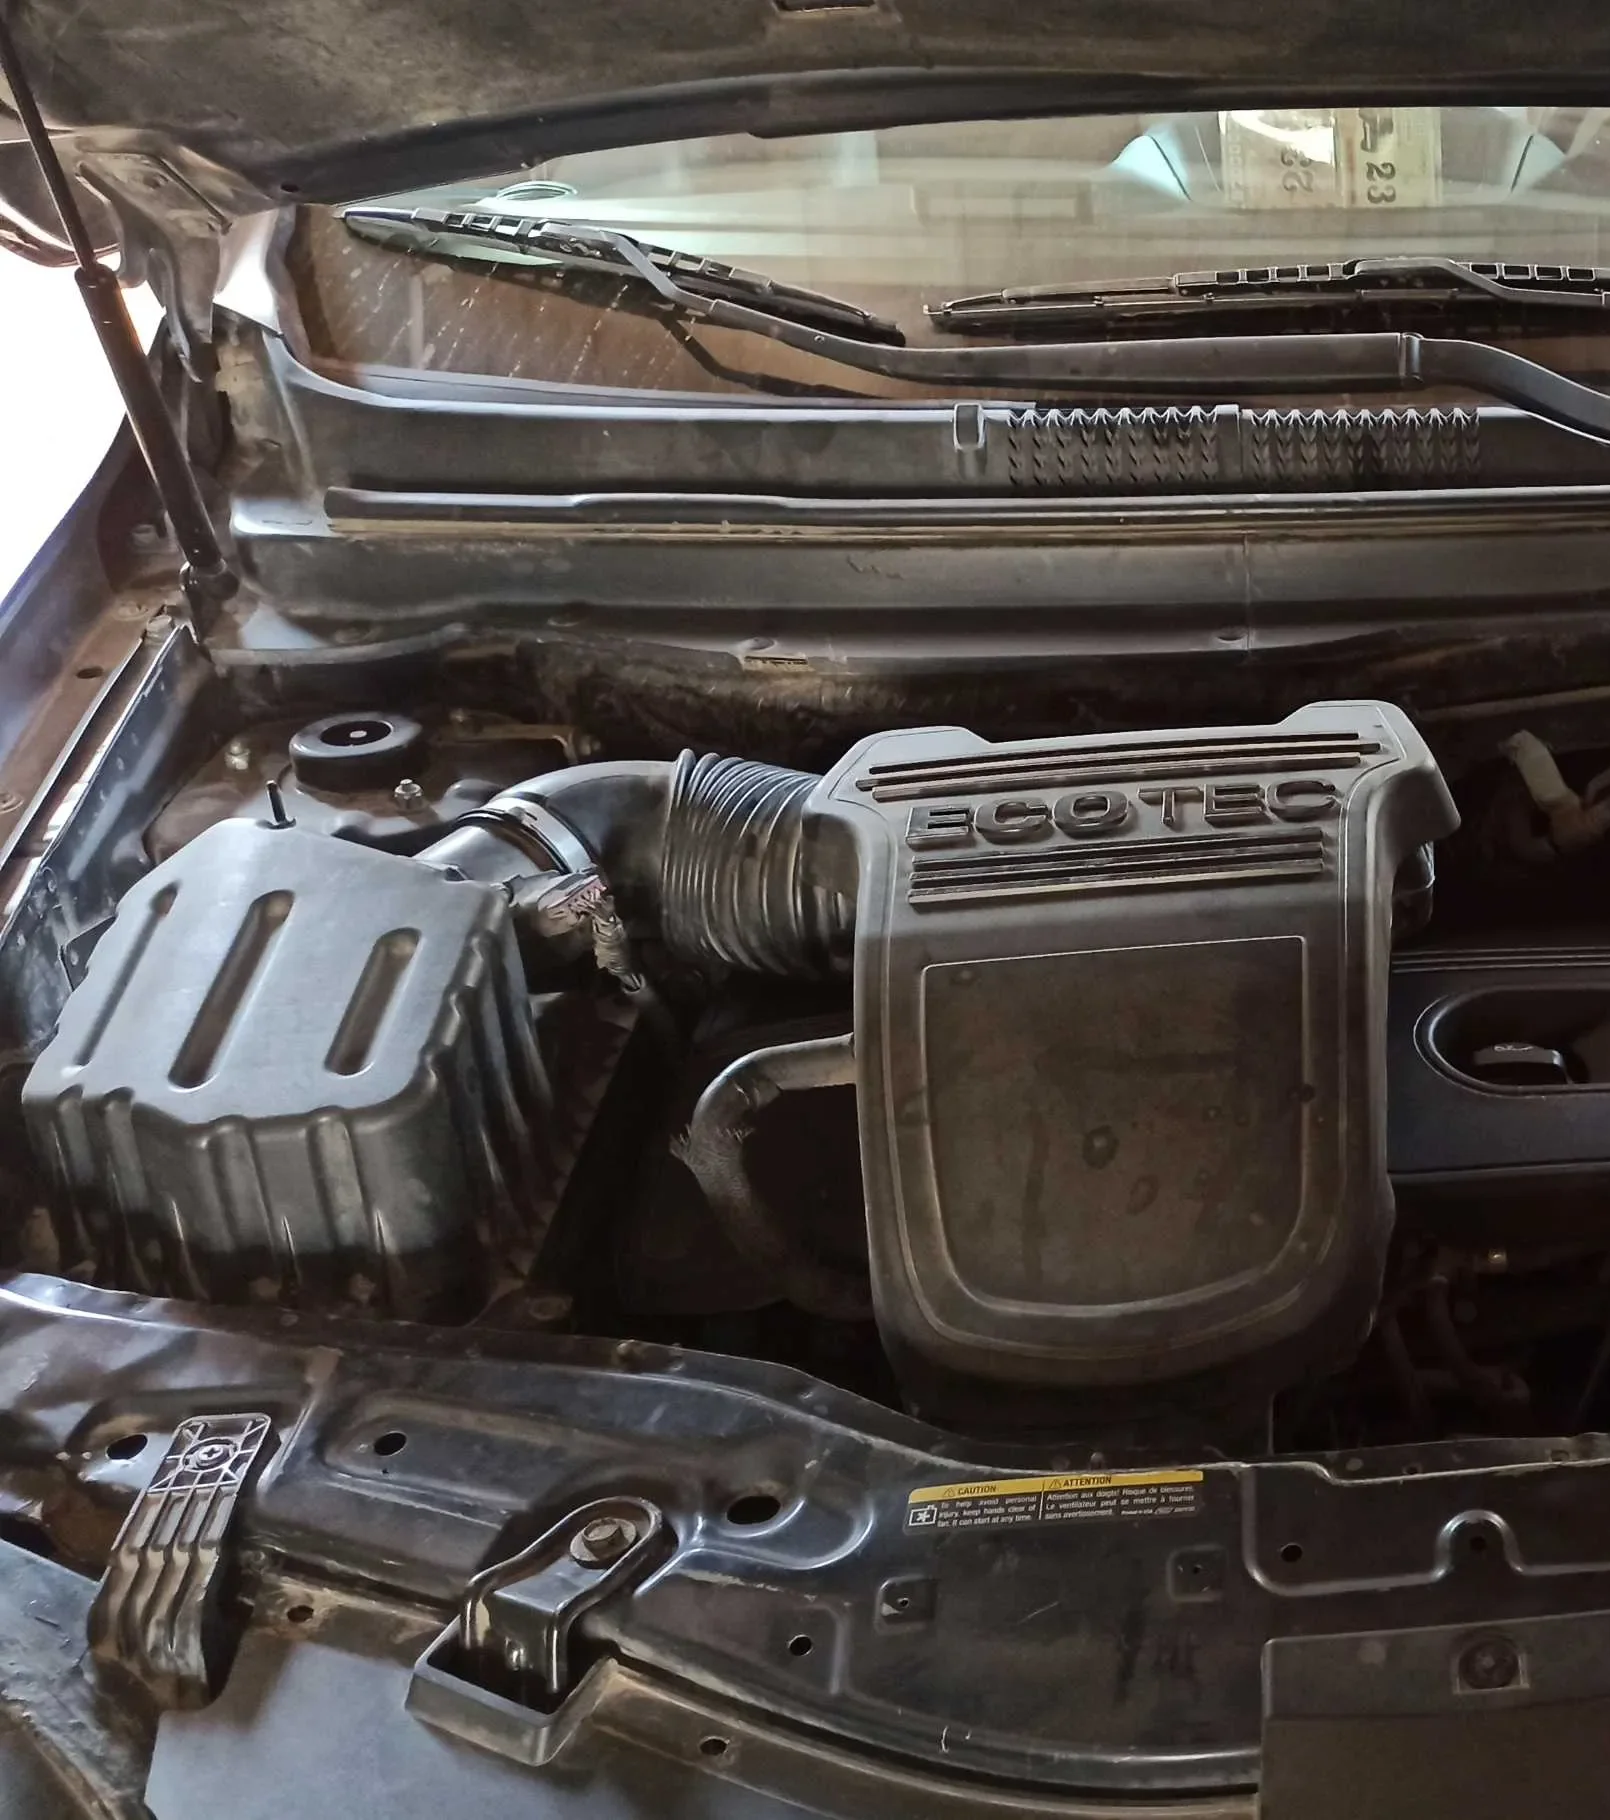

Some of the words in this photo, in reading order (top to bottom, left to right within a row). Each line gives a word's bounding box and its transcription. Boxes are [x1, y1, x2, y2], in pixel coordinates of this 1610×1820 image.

[1366, 161, 1398, 205] 23
[905, 778, 1339, 848] ECOTEC
[958, 1486, 996, 1495] CAUTION
[1063, 1477, 1111, 1487] ATTENTION
